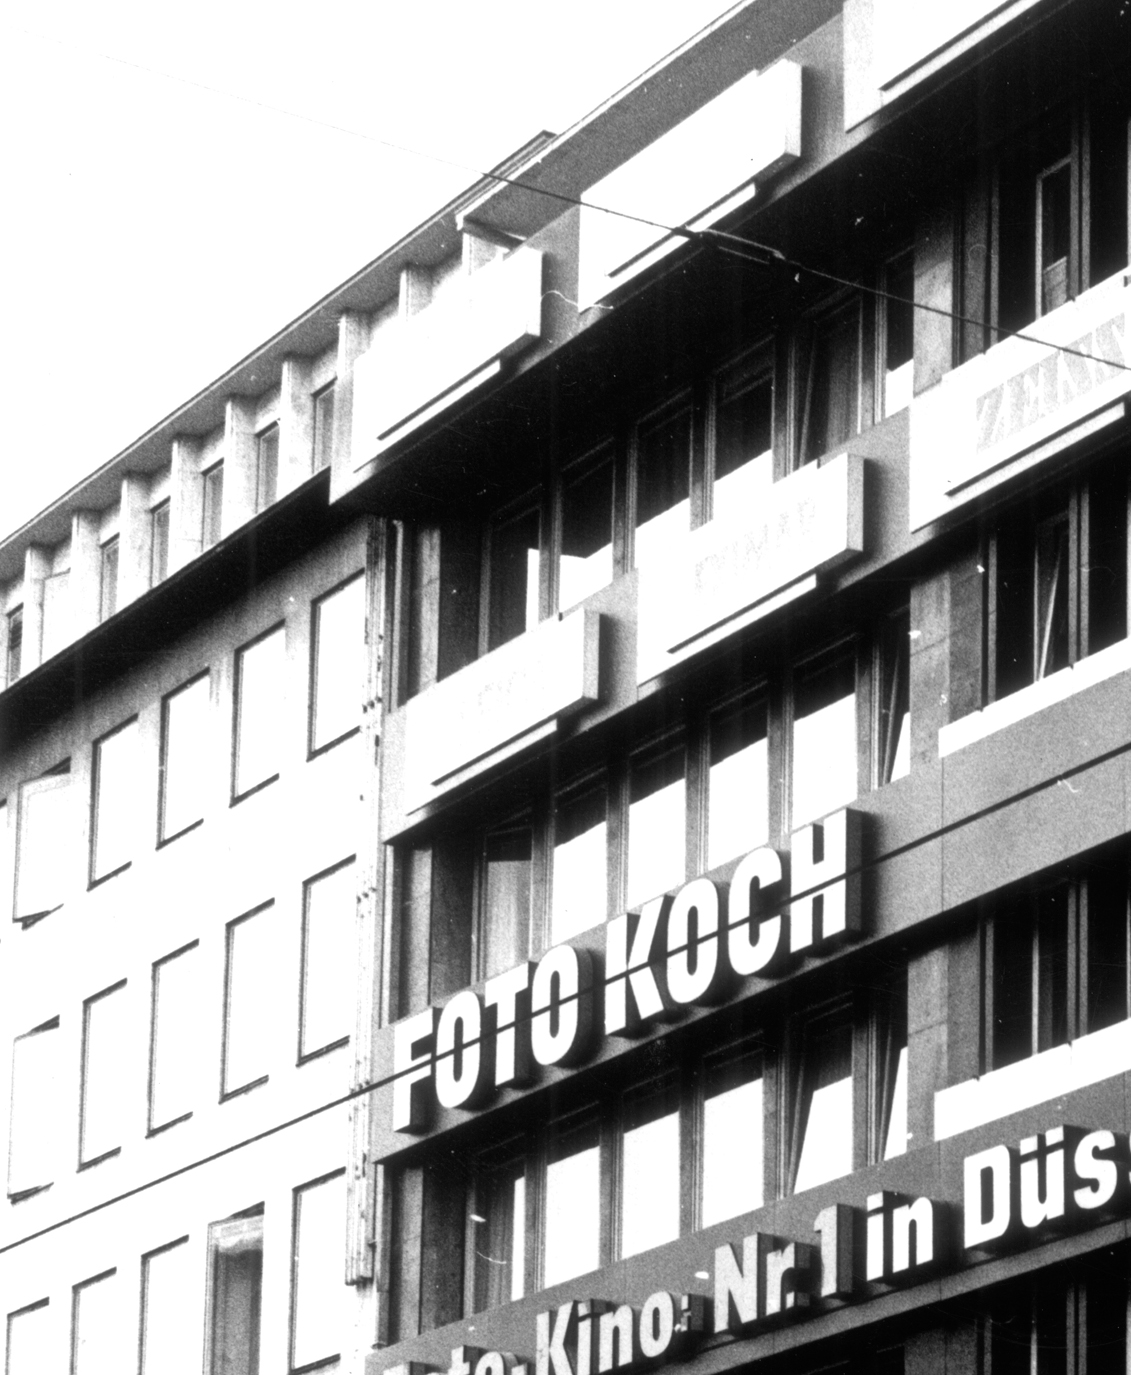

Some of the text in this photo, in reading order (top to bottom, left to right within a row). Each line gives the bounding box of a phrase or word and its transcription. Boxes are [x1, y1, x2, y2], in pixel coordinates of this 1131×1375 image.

[393, 808, 848, 1132] FOTO KOCH
[865, 1191, 934, 1282] in
